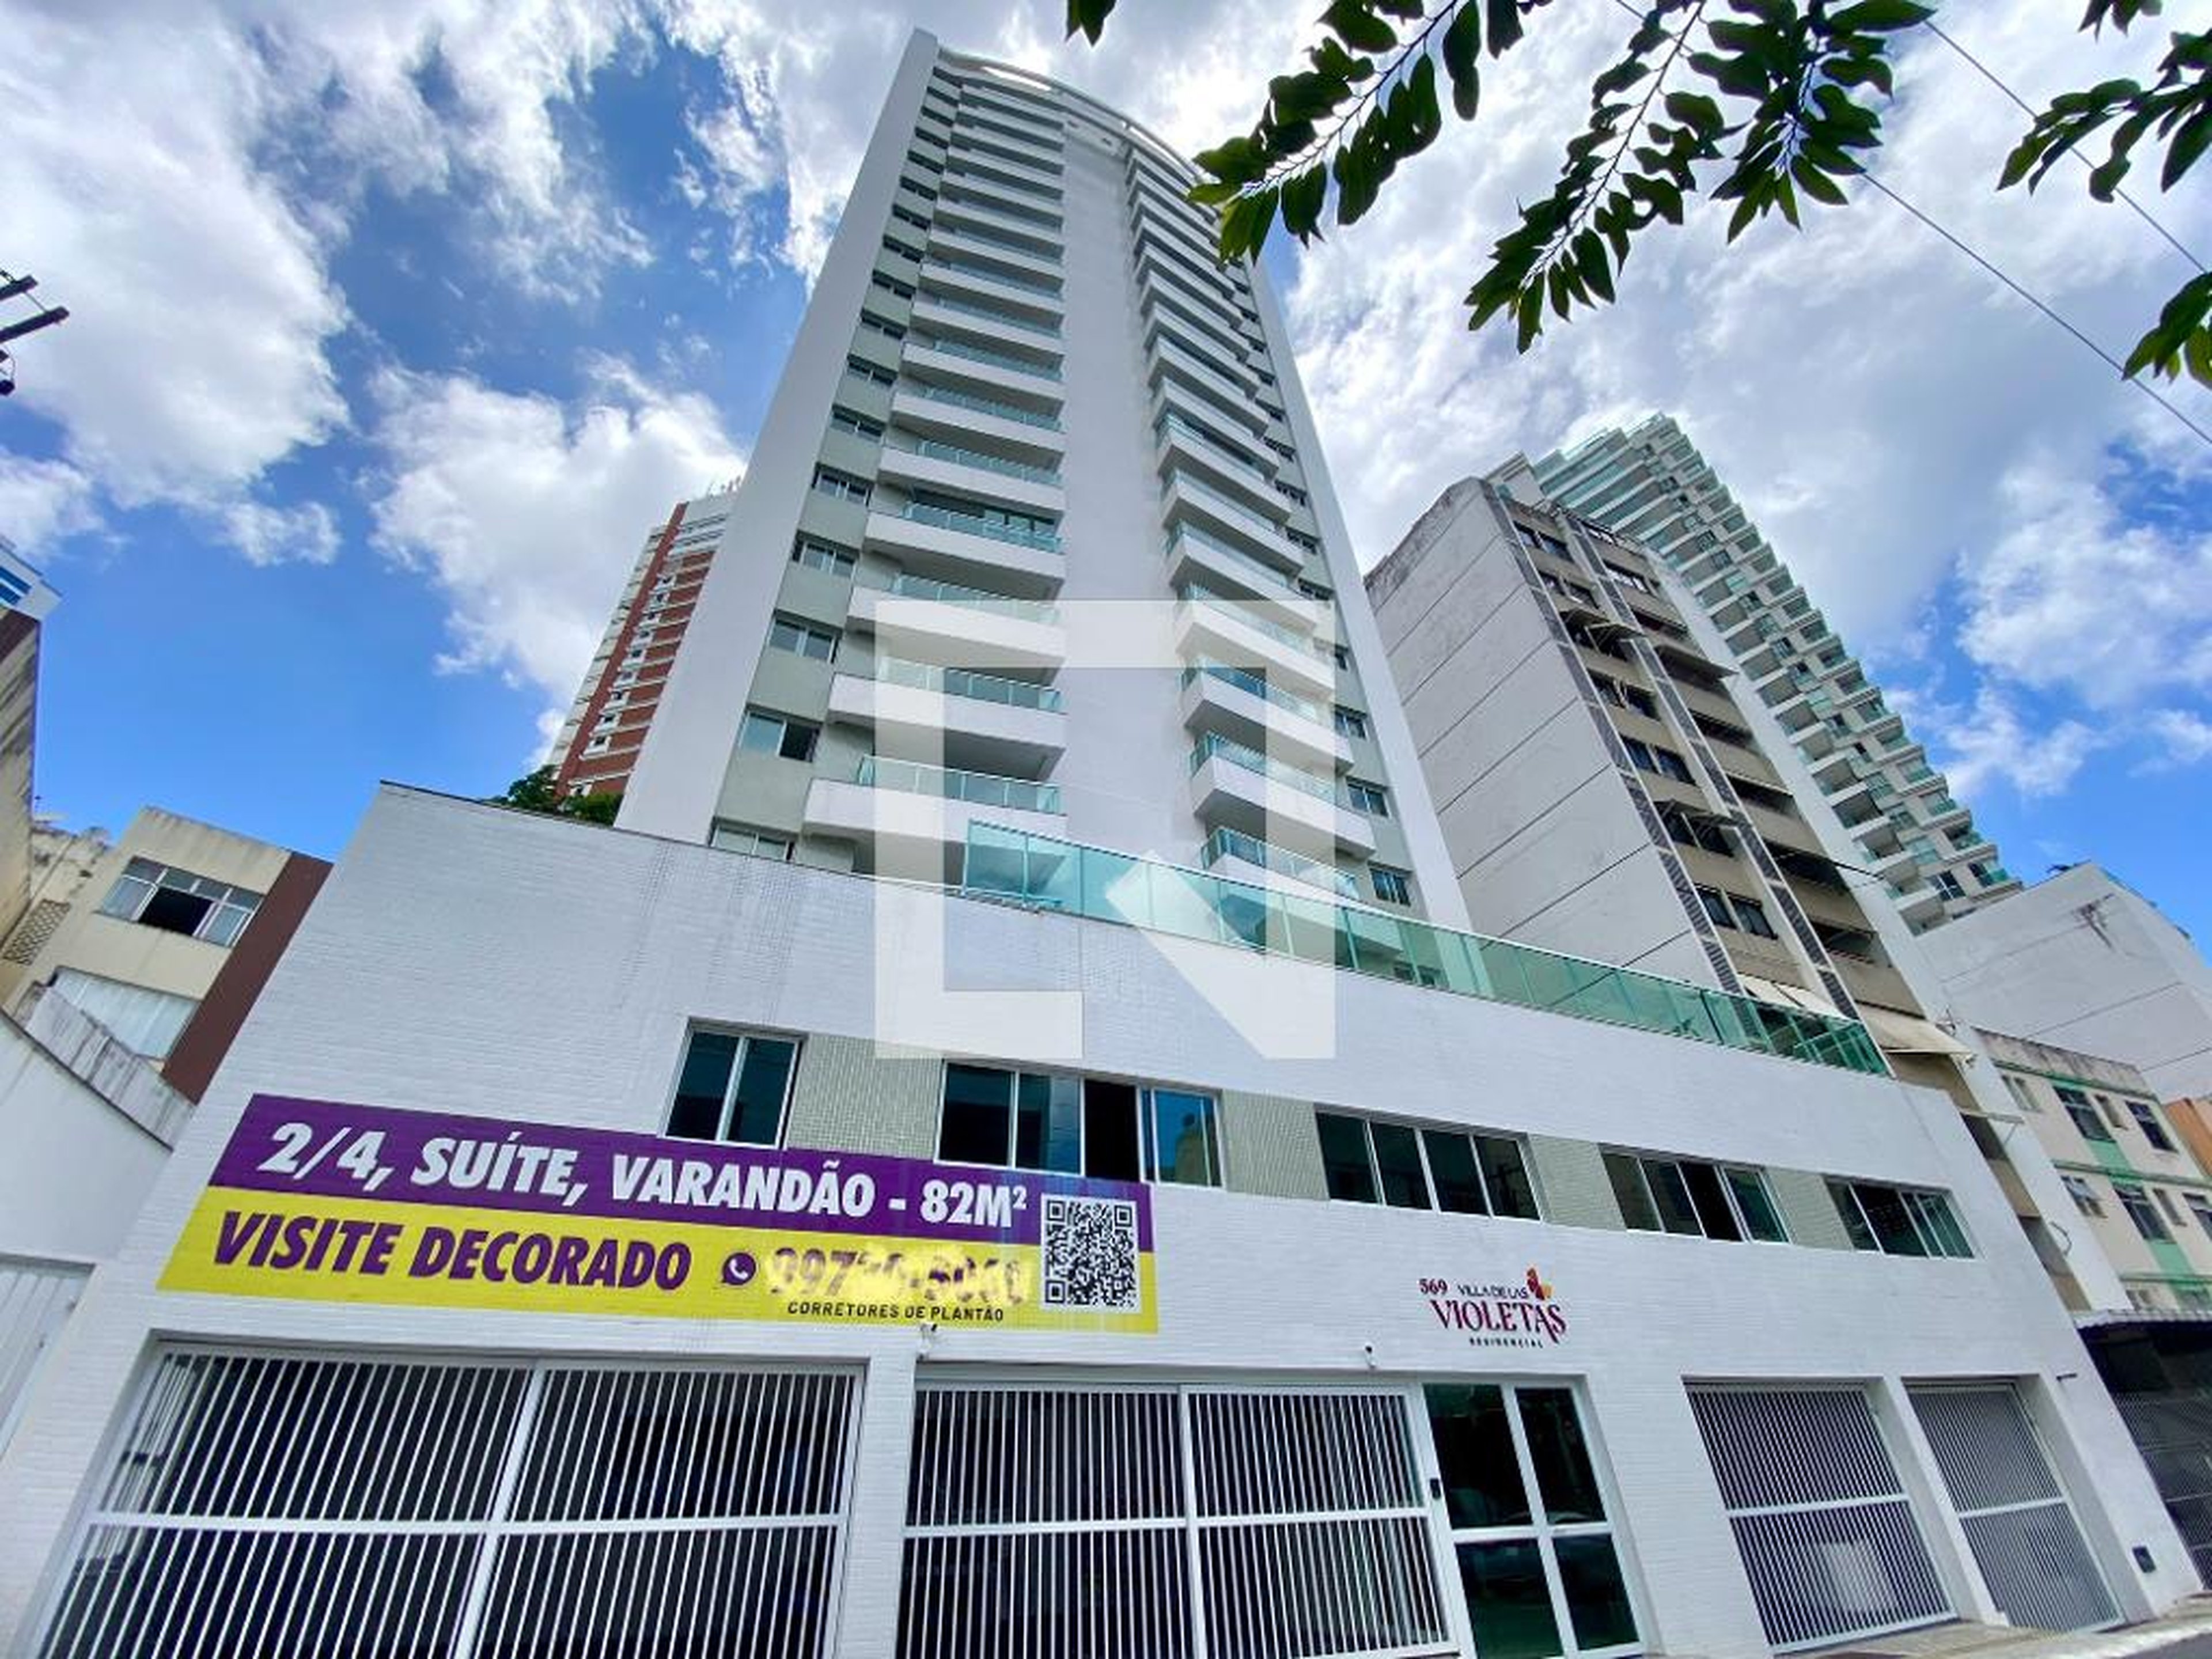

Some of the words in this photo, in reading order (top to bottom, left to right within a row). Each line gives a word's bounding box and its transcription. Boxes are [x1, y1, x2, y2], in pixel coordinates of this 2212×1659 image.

[259, 1122, 393, 1191] 2/4,
[411, 1132, 588, 1206] SUÍTE,
[612, 1155, 876, 1218] VARANDÃO
[214, 1211, 404, 1275] VISITE
[408, 1225, 692, 1291] DECORADO
[1419, 1278, 1448, 1295] 569
[1457, 1284, 1490, 1297] VILLA
[1491, 1286, 1508, 1298] DE
[1508, 1287, 1529, 1300] LAS
[787, 1301, 899, 1319] CORRETORES
[905, 1306, 926, 1319] DE
[930, 1304, 1004, 1321] PLANTÃO
[1430, 1298, 1567, 1344] VIOLETAS
